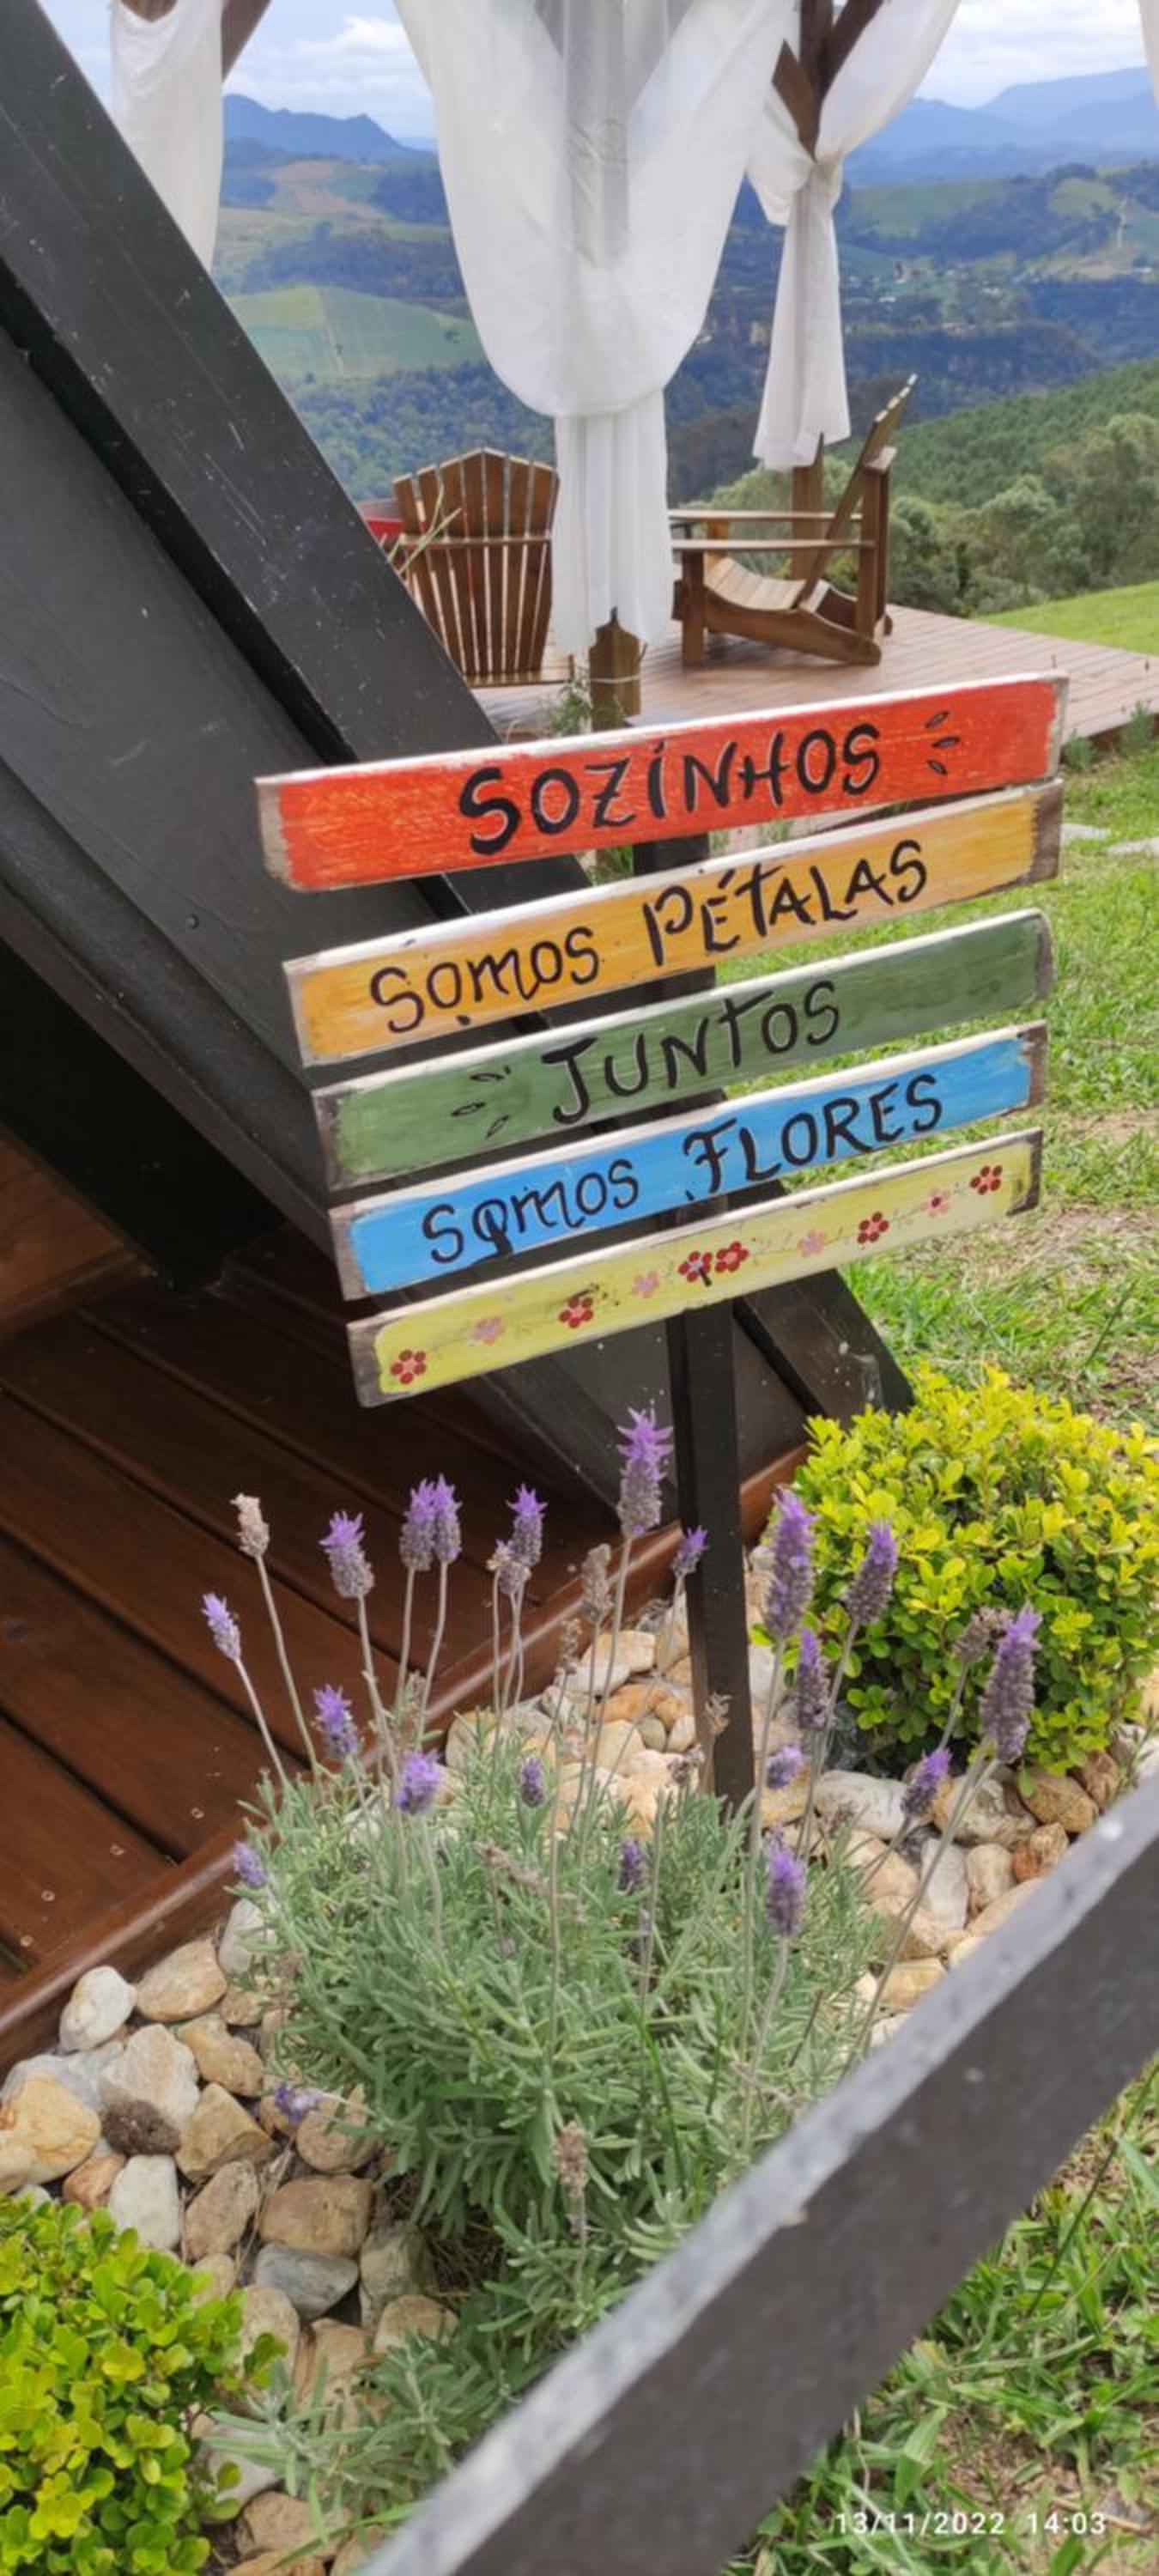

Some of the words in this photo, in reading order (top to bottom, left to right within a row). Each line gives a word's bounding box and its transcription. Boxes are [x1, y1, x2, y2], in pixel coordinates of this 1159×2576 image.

[642, 838, 928, 966] PÉTALAS
[542, 979, 840, 1124] JUNTOS
[683, 1073, 943, 1194] FLORES
